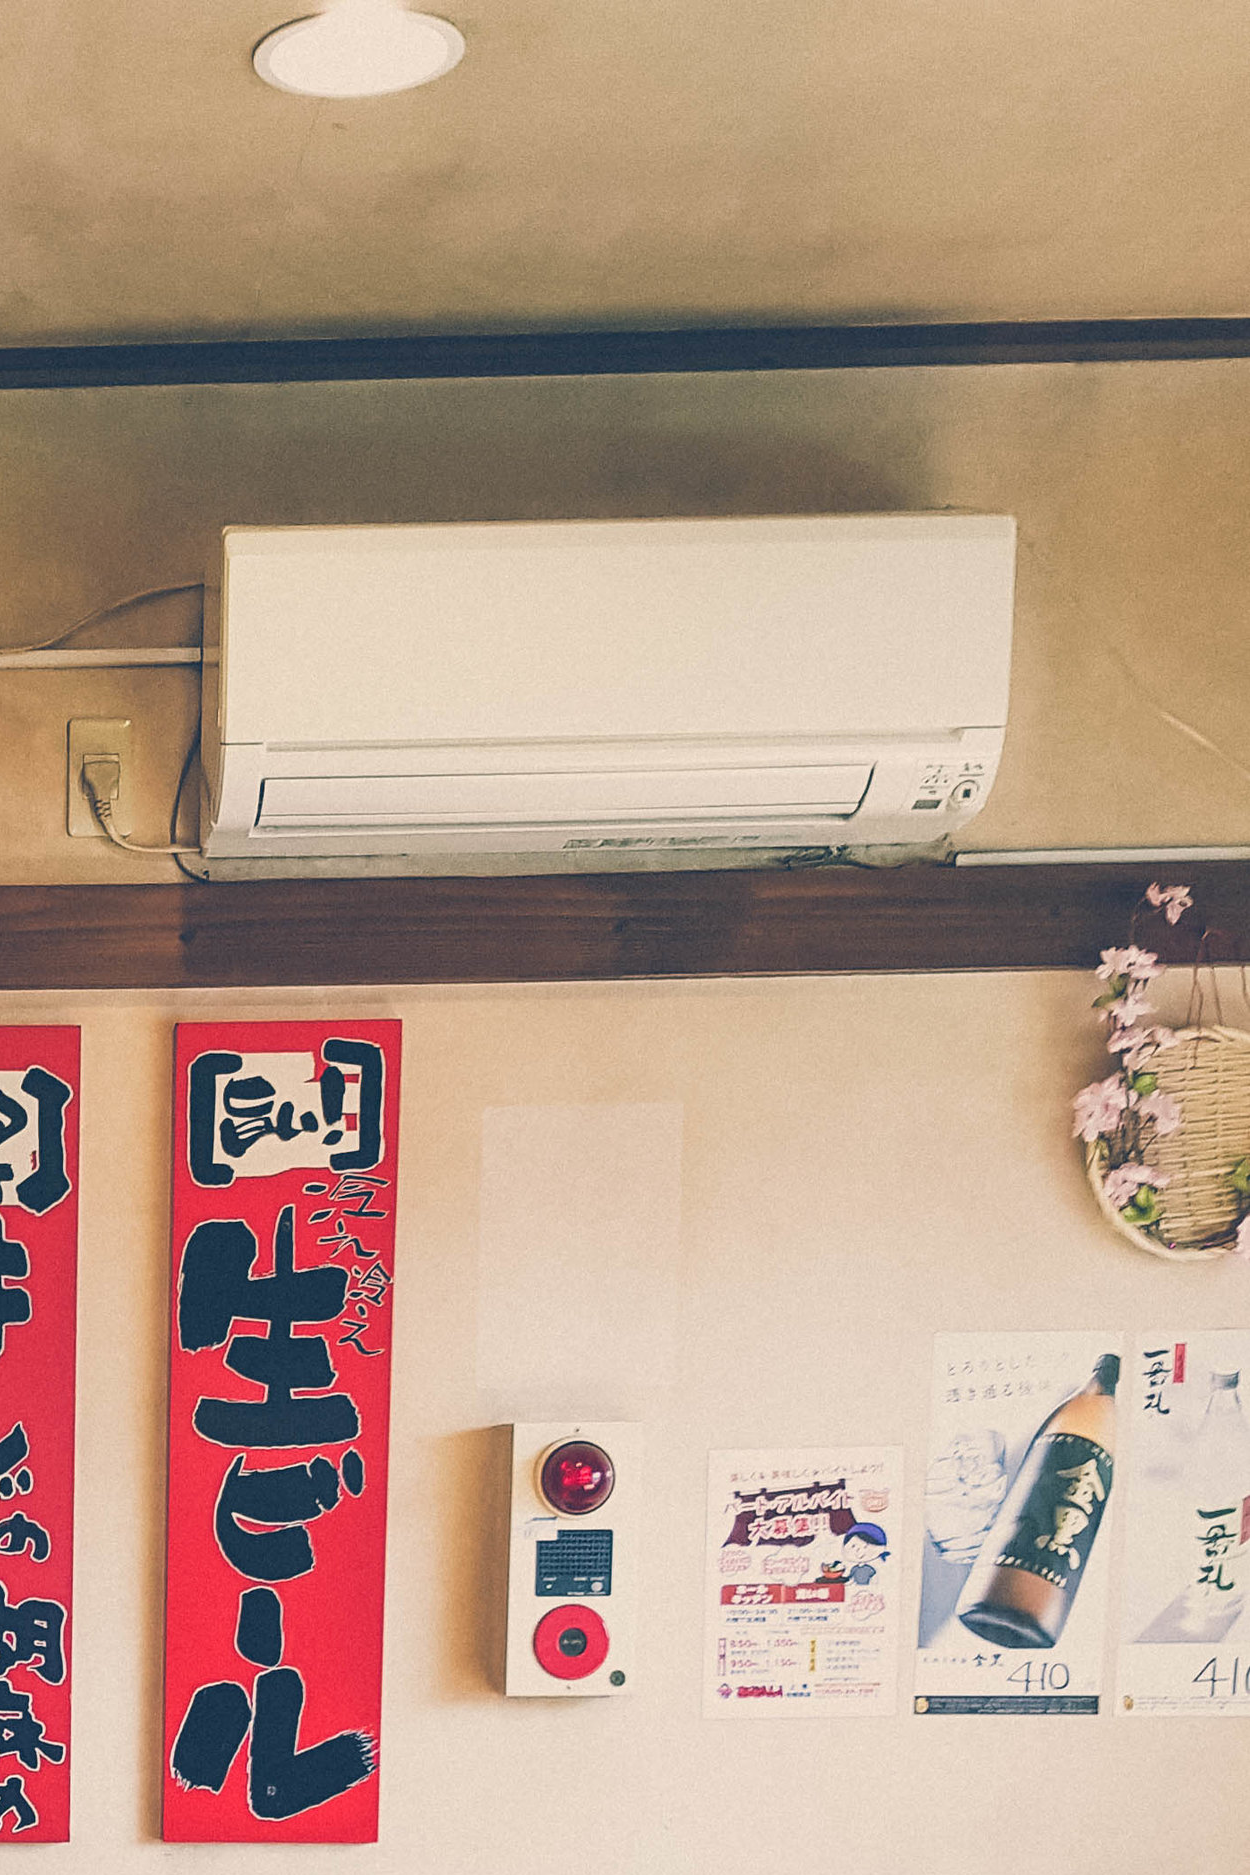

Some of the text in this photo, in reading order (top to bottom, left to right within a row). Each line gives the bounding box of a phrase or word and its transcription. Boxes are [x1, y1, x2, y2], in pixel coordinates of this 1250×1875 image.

[170, 1203, 380, 1822] 生ビール
[1005, 1660, 1071, 1693] 410
[1191, 1655, 1250, 1698] 41
